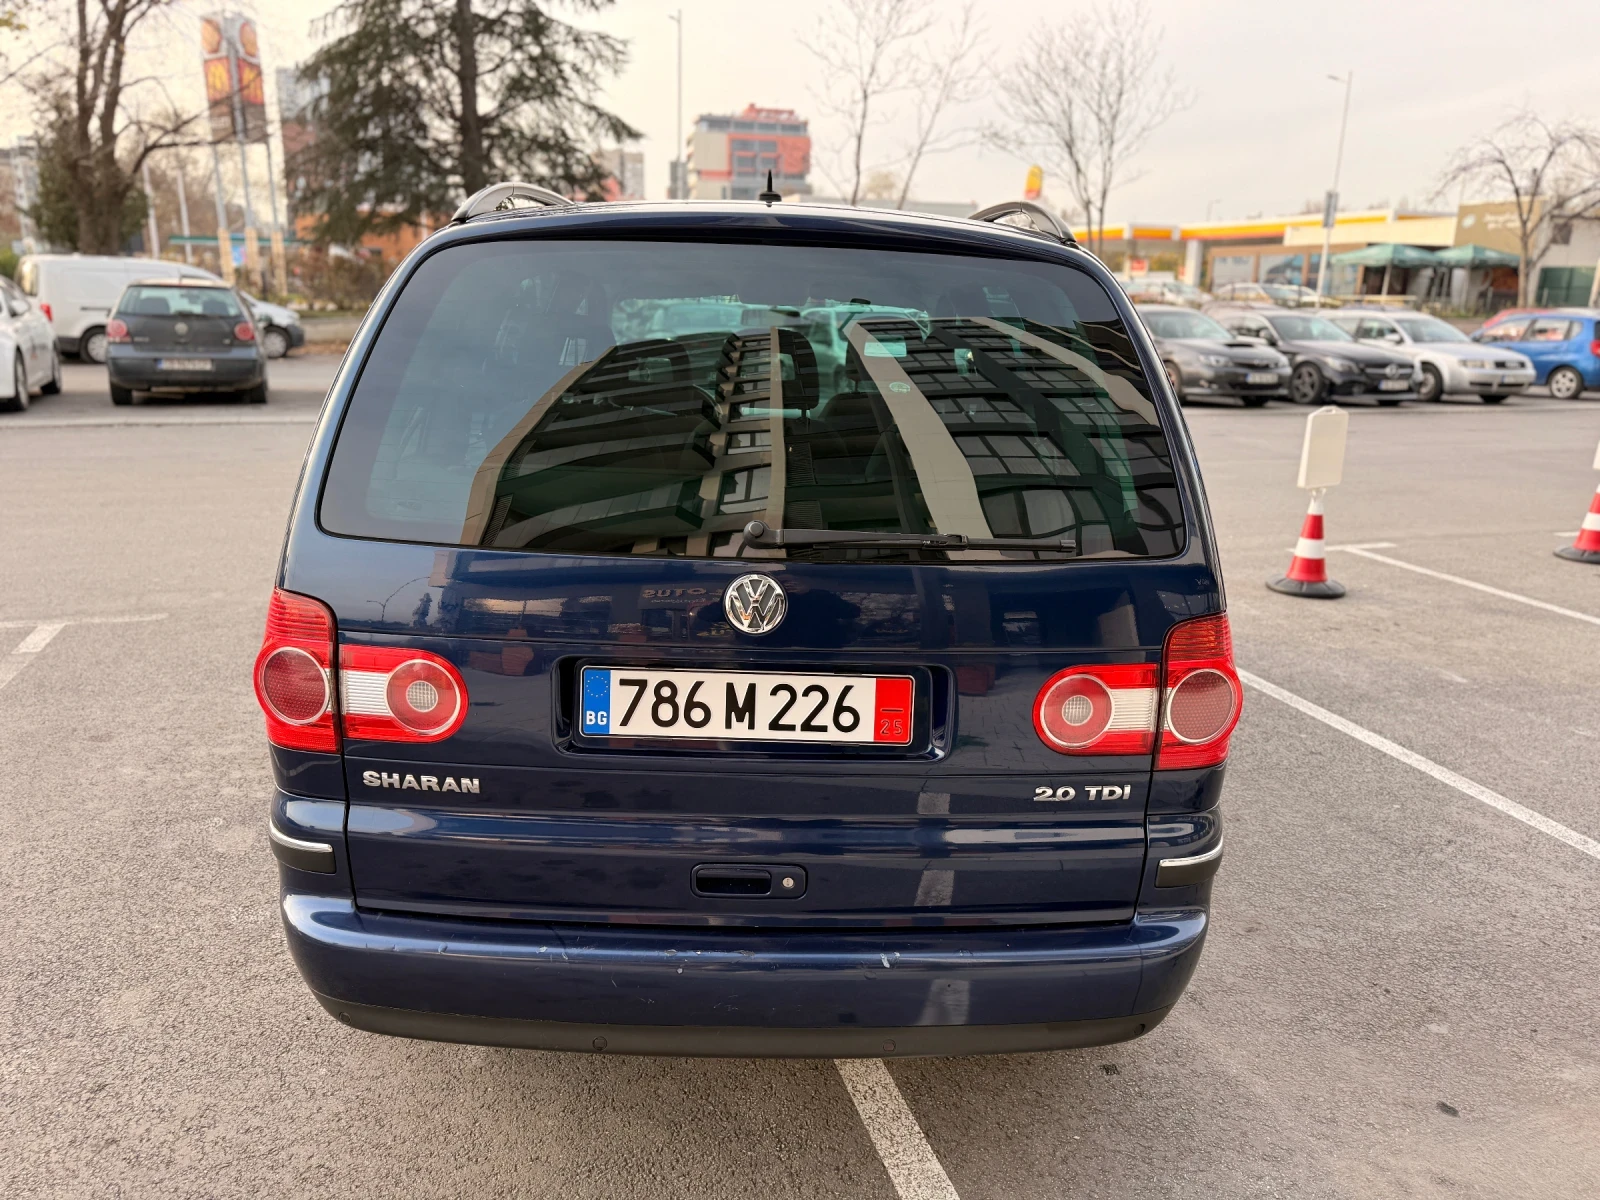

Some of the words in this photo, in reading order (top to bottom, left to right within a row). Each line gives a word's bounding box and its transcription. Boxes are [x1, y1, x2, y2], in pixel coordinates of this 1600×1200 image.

[618, 678, 712, 729] 786
[724, 682, 756, 730] M
[768, 683, 860, 733] 226
[586, 710, 608, 726] BG
[880, 719, 903, 735] 25
[362, 770, 480, 794] SHARAN
[1084, 784, 1131, 800] TDI
